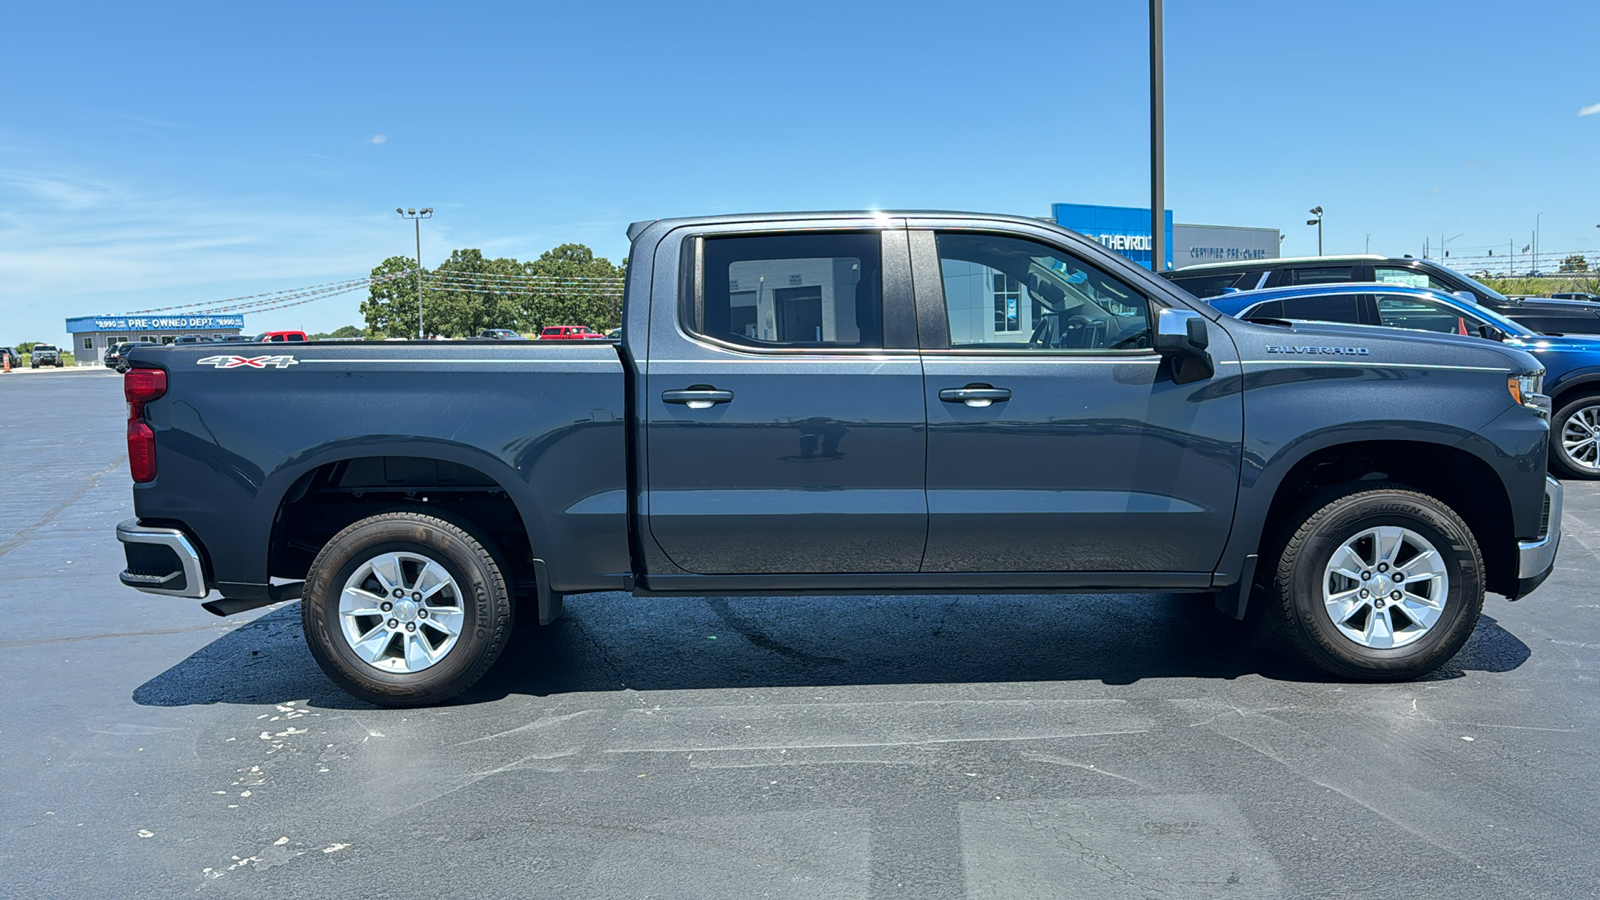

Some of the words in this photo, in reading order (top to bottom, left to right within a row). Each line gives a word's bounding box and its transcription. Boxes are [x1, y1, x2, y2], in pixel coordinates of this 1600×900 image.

[1190, 246, 1223, 259] CERTIFIED
[1226, 248, 1265, 259] PRE-OWNED
[128, 318, 187, 328] PRE-OWNED
[190, 318, 215, 327] DEPT.
[1265, 345, 1370, 356] SILVERADO
[473, 581, 488, 639] KUMHO
